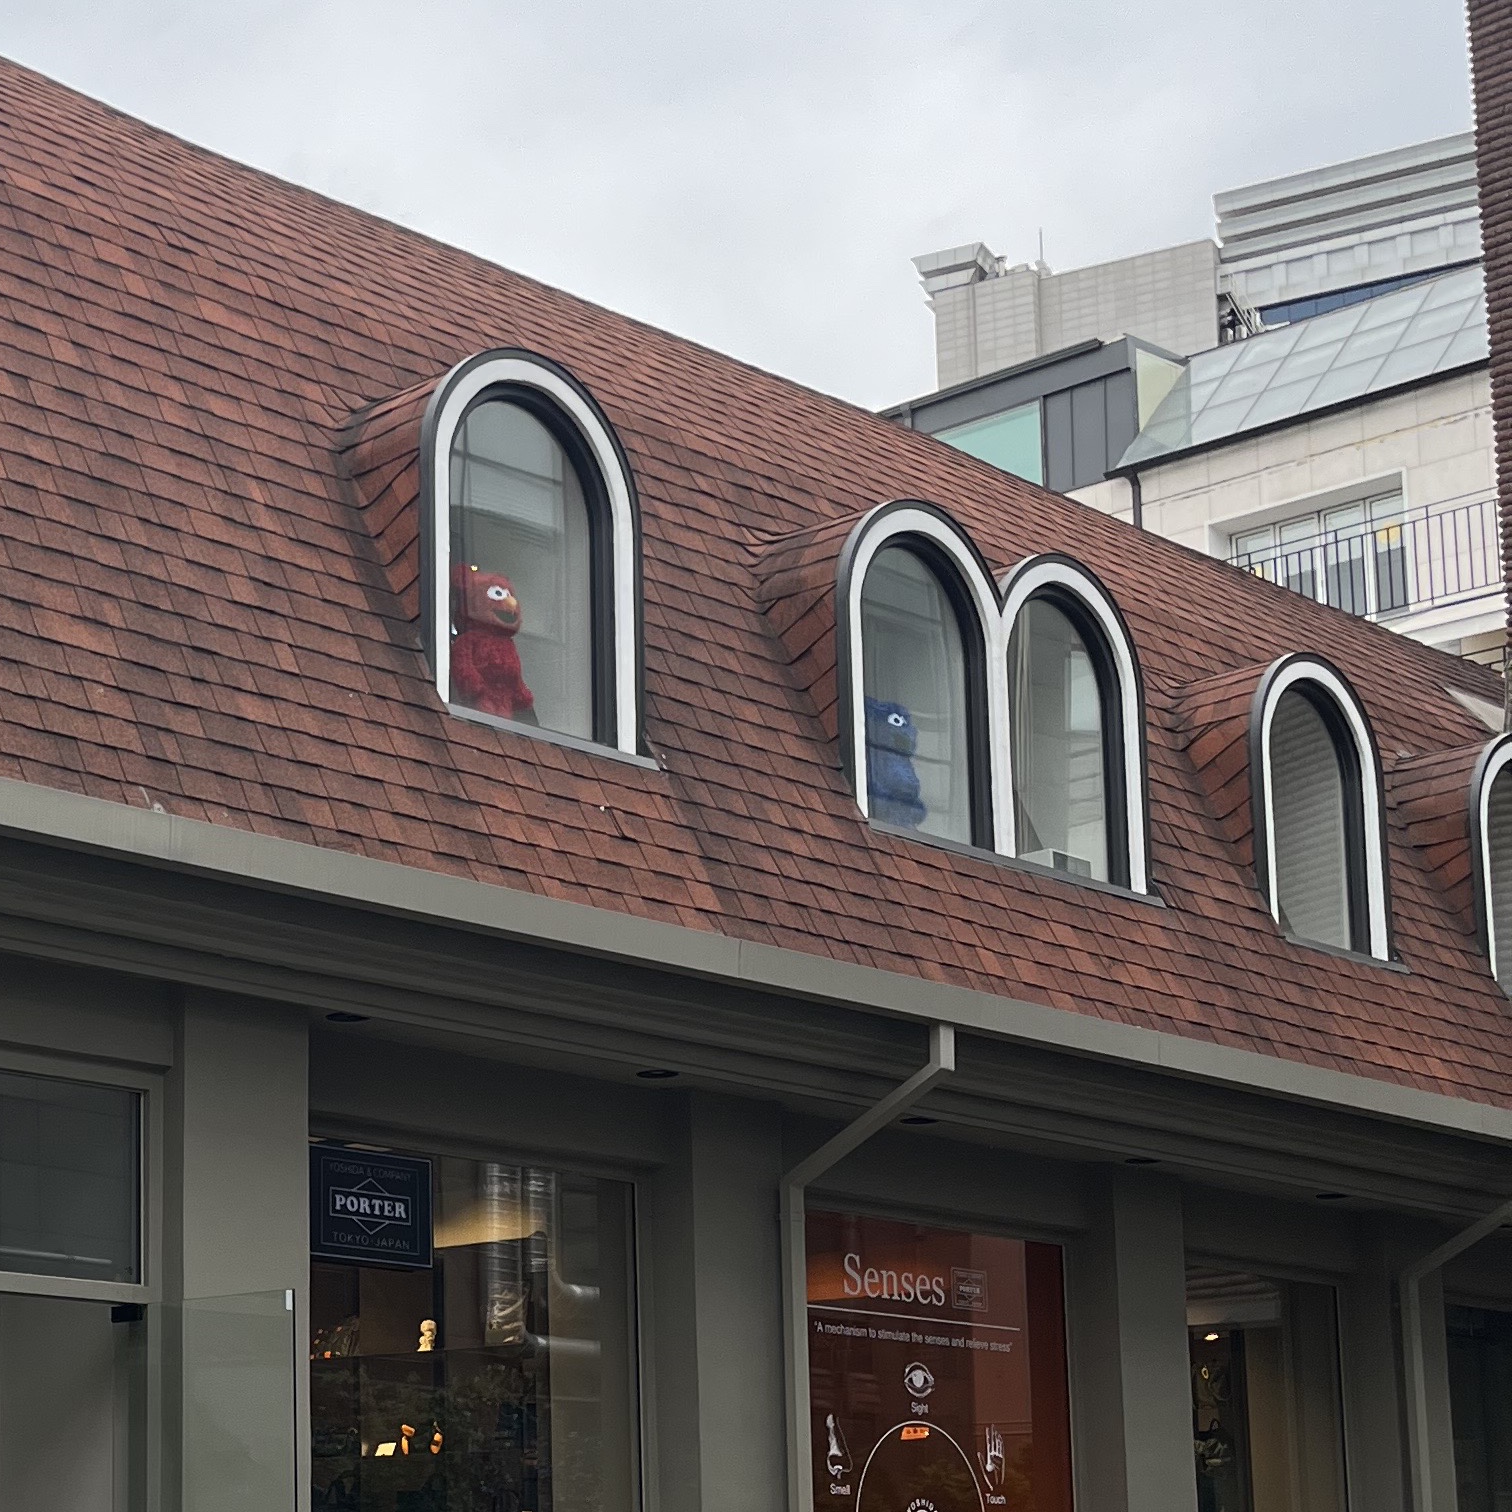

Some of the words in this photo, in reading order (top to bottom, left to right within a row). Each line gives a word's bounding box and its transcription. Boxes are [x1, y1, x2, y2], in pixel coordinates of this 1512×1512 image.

[329, 1162, 364, 1174] YOSHIDA
[374, 1168, 411, 1181] COMPANY
[334, 1194, 406, 1218] PORTER
[332, 1231, 369, 1245] TOKYO
[375, 1238, 409, 1249] JAPAN
[843, 1253, 945, 1306] Senses
[824, 1323, 867, 1337] mechanism
[868, 1328, 876, 1338] to
[877, 1329, 910, 1342] stimulate
[911, 1332, 923, 1343] the
[924, 1335, 949, 1346] senses
[951, 1337, 964, 1347] and
[965, 1338, 988, 1350] relieve
[910, 1402, 929, 1416] Sight
[830, 1484, 851, 1495] Smell
[986, 1493, 1006, 1505] Touch
